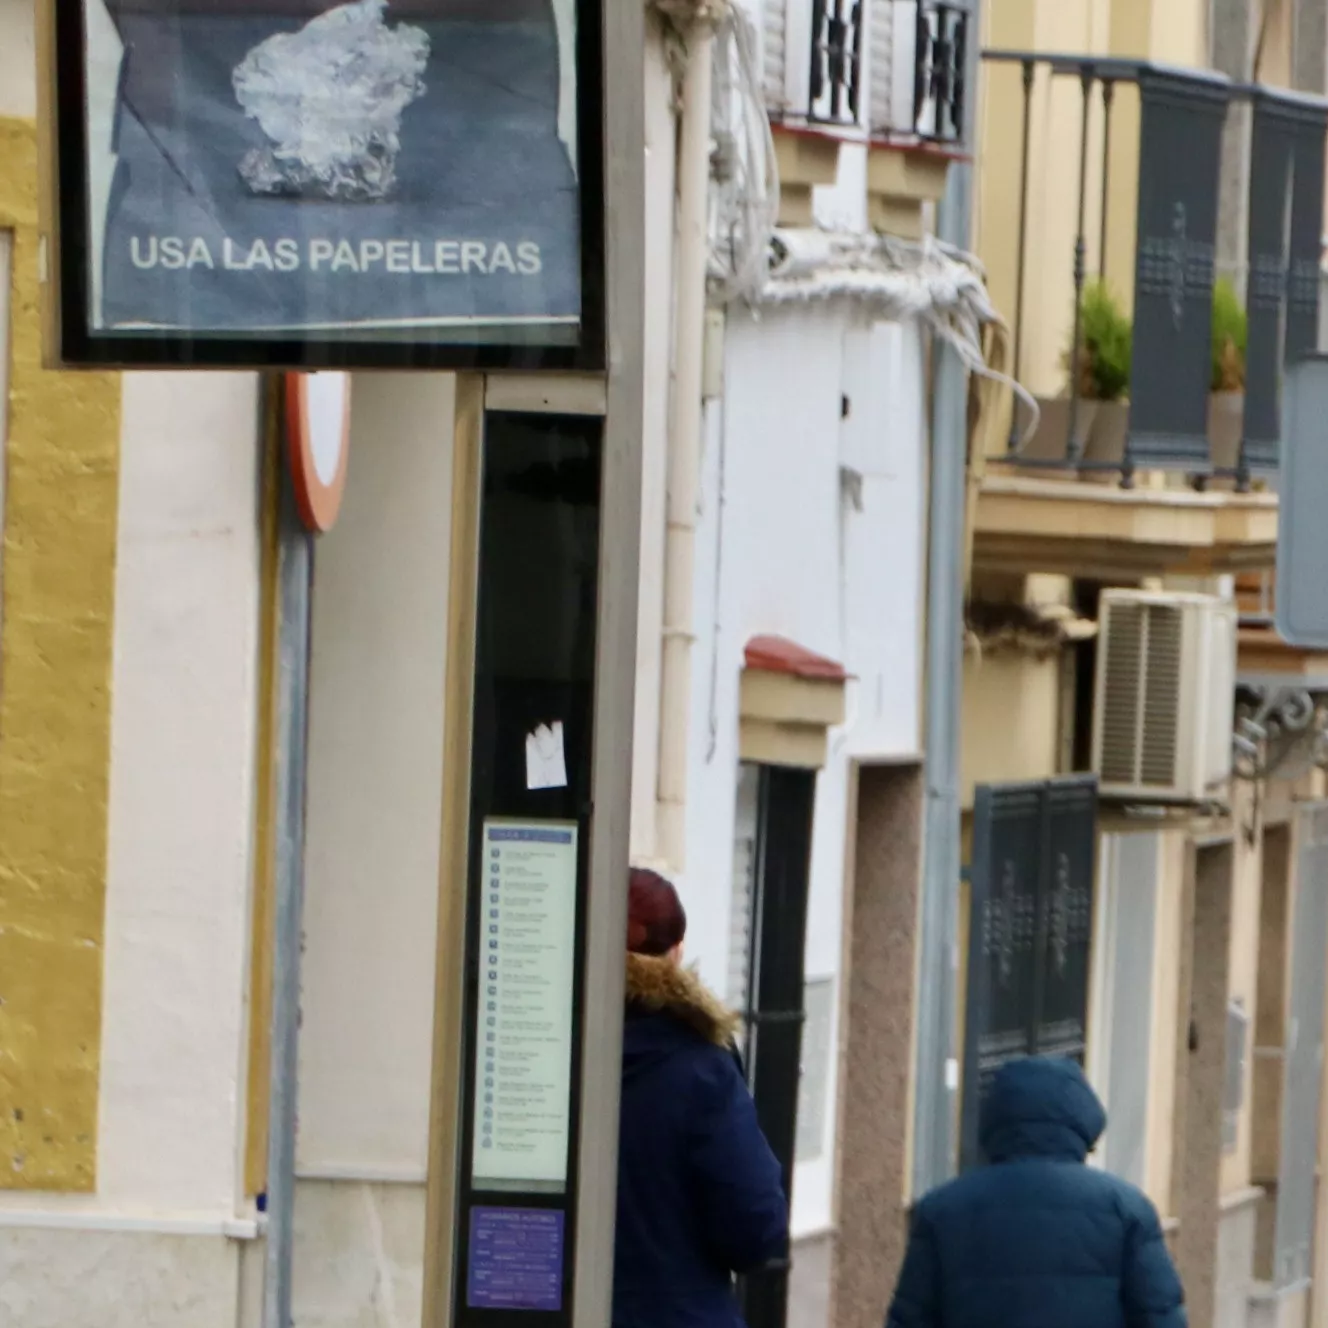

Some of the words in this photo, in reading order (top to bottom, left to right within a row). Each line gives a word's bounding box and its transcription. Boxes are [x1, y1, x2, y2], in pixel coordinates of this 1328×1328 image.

[130, 237, 213, 269] USA
[223, 238, 299, 270] LAS
[309, 240, 542, 274] PAPELERAS
